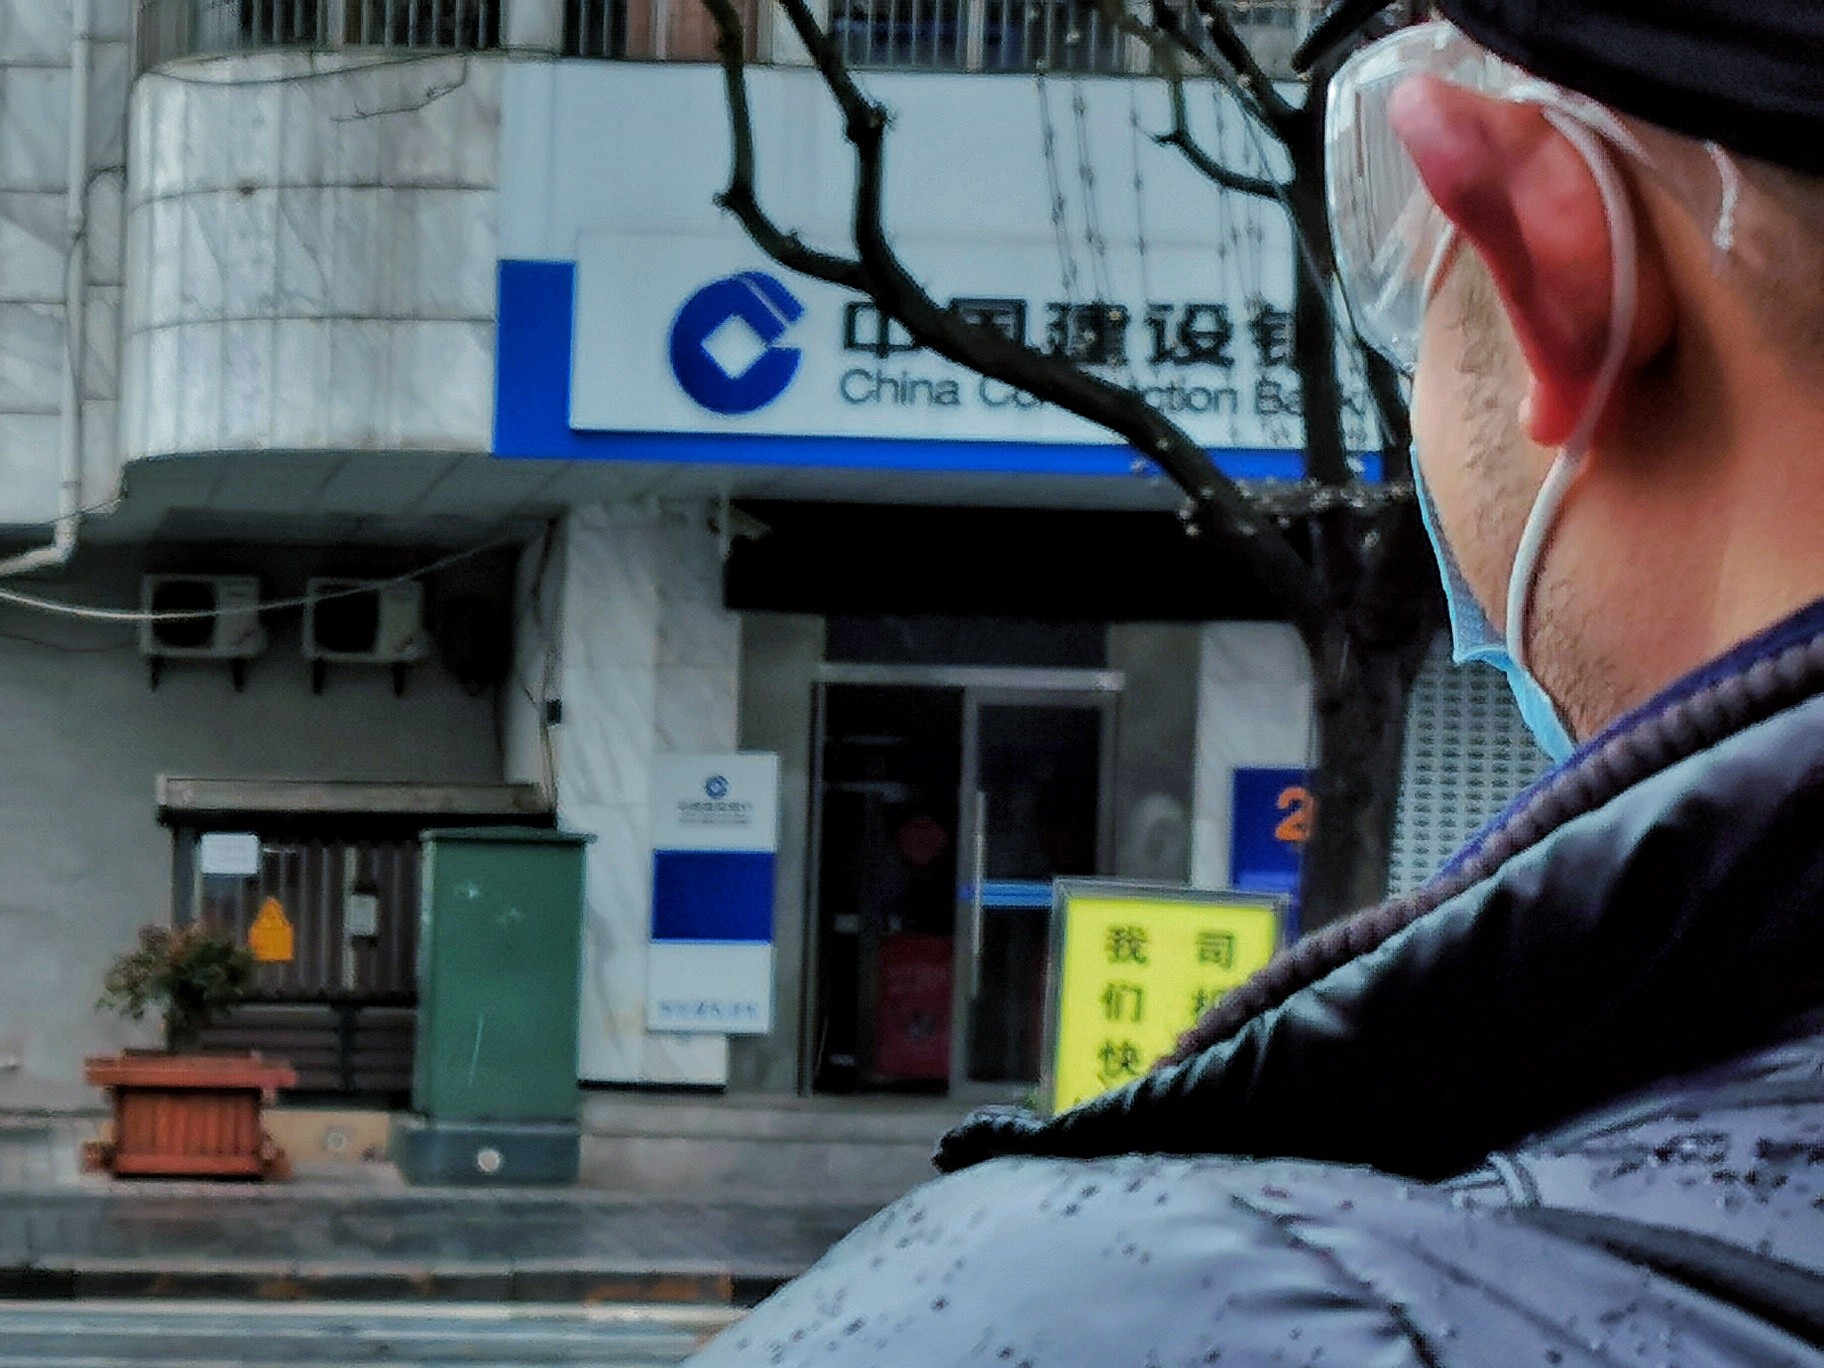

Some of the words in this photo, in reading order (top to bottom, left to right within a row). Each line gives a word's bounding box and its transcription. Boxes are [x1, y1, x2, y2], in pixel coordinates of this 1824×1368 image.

[839, 366, 960, 405] China
[979, 373, 1239, 413] Coction
[1098, 924, 1150, 1090] 我们快
